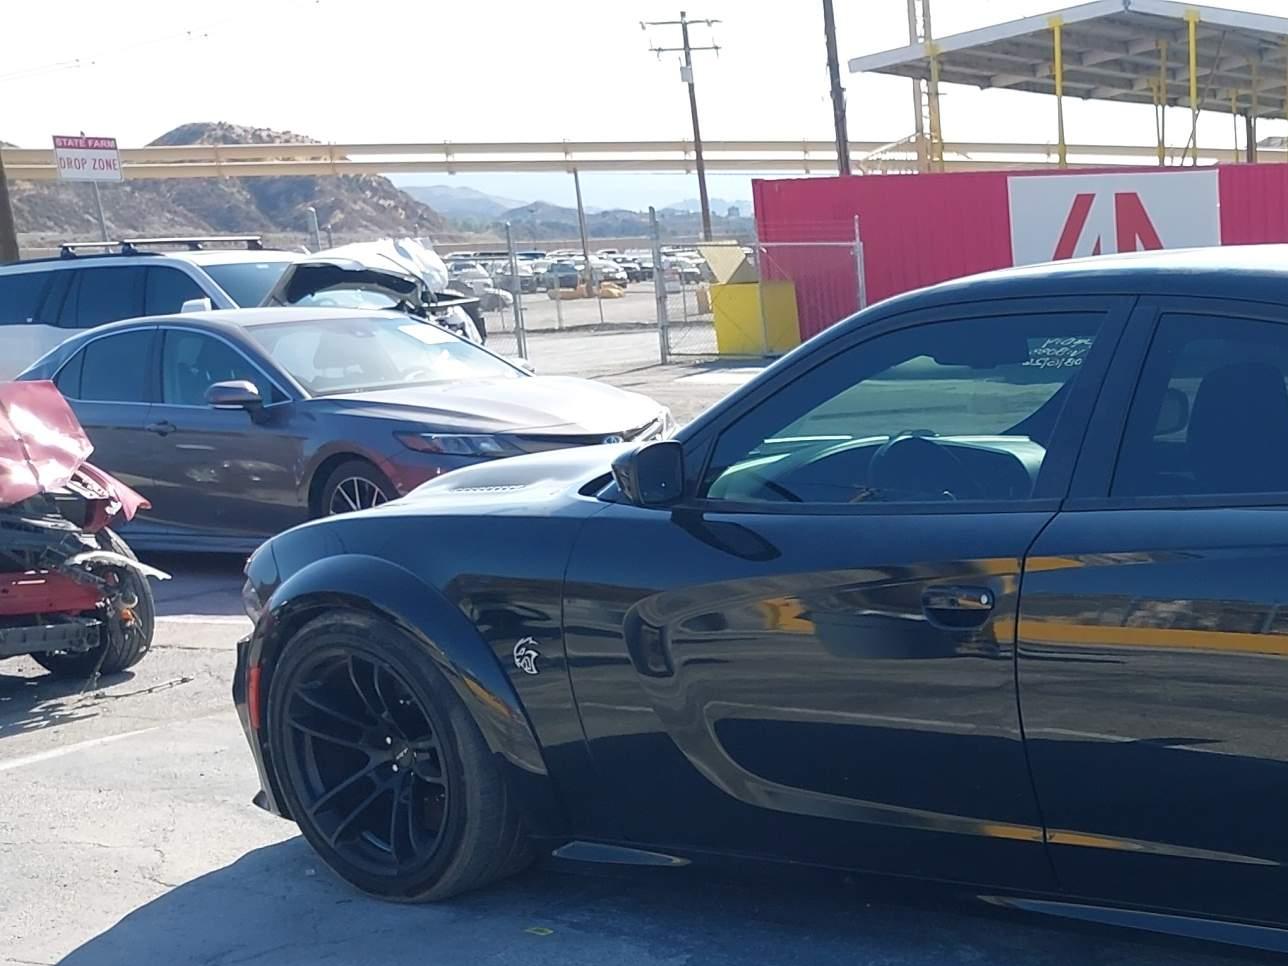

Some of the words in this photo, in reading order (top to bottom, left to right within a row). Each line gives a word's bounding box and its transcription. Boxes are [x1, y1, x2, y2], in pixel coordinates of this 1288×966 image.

[56, 138, 86, 147] STATE
[88, 139, 115, 148] FARM
[59, 157, 87, 169] DROP
[92, 158, 118, 170] ZONE
